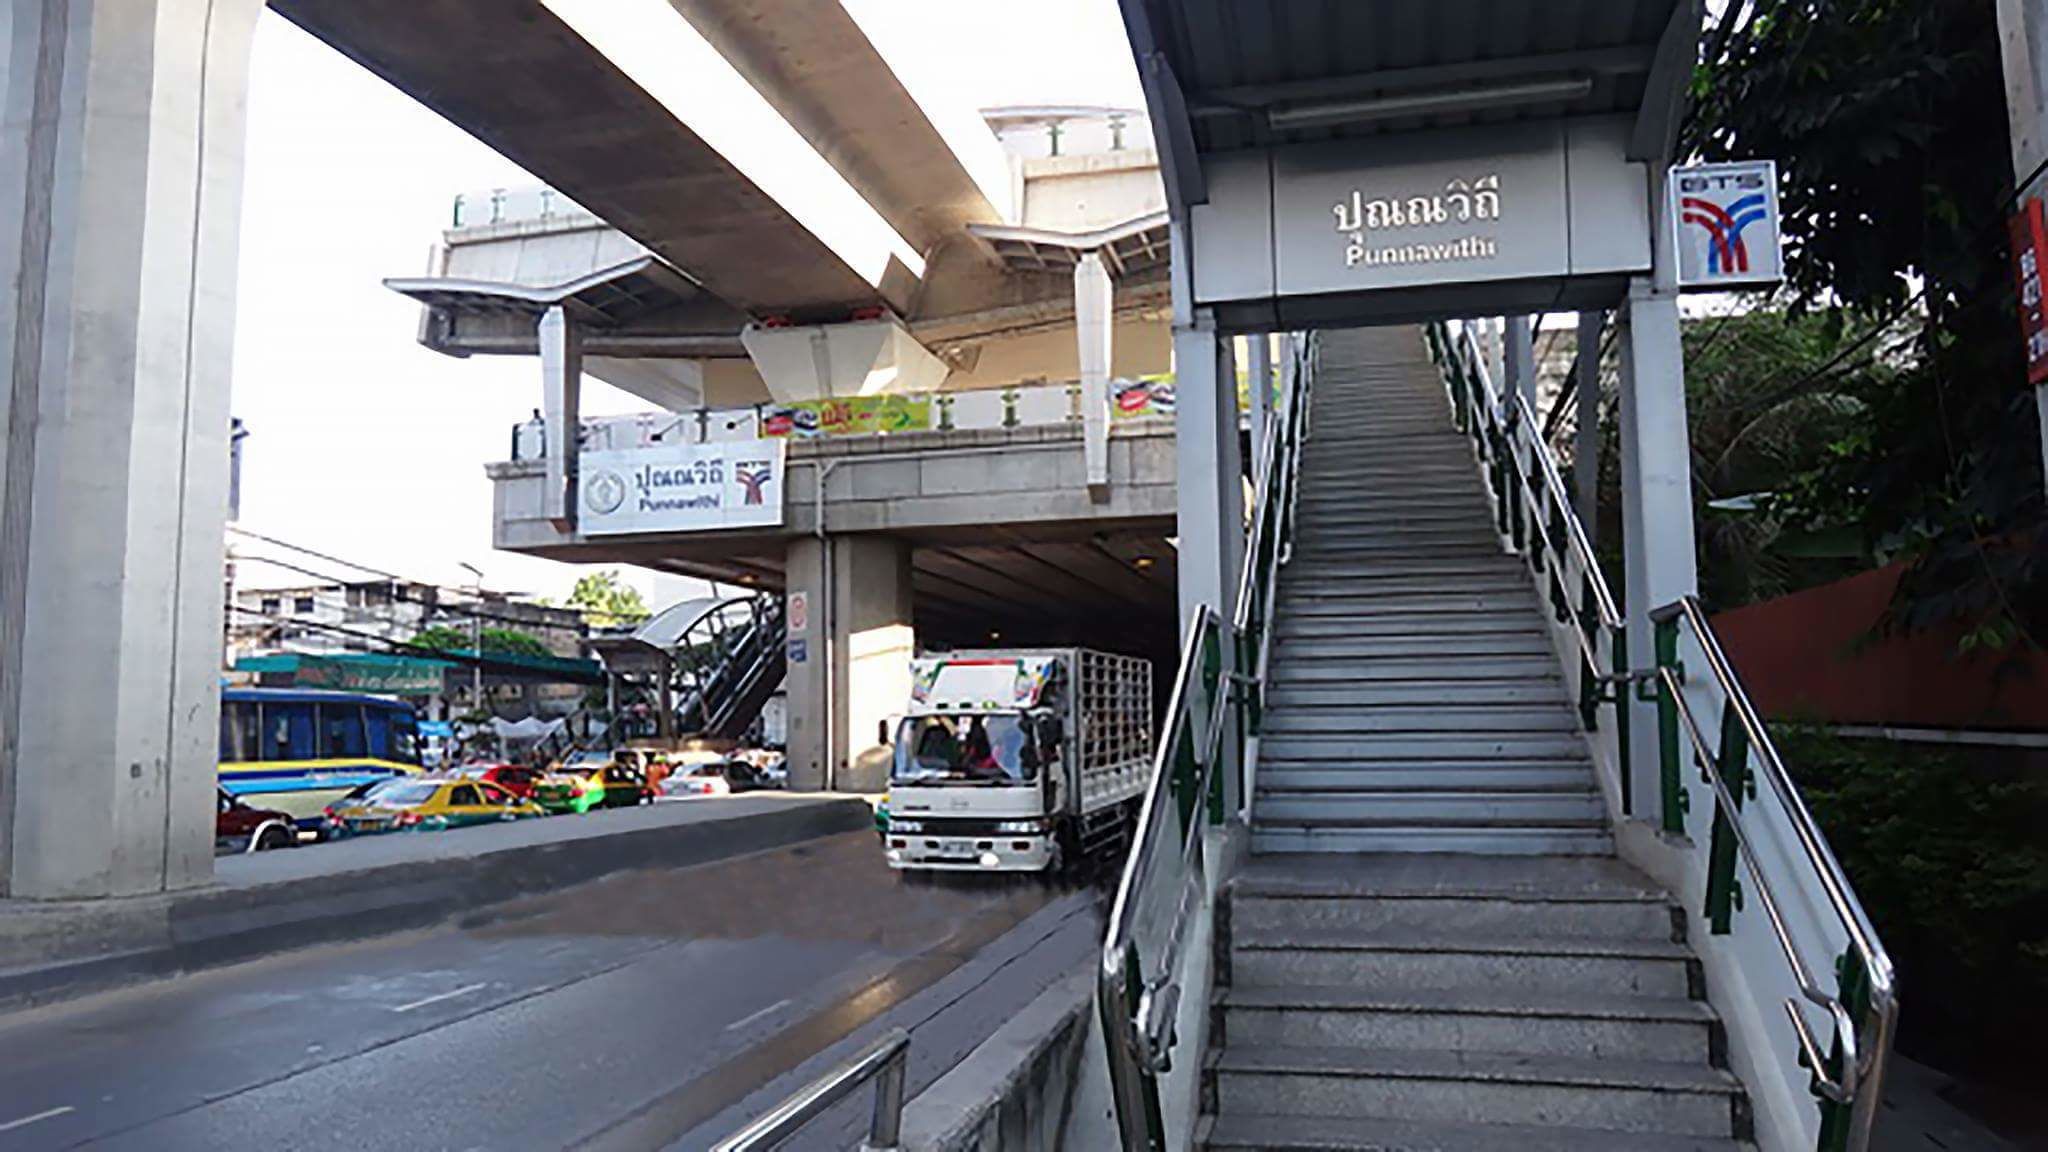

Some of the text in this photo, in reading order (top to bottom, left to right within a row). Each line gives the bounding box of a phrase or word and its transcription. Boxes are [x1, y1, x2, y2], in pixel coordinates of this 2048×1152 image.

[1680, 173, 1764, 192] BTS
[1333, 175, 1499, 244] ปุณณวิถี
[1346, 236, 1495, 266] Punnawithi
